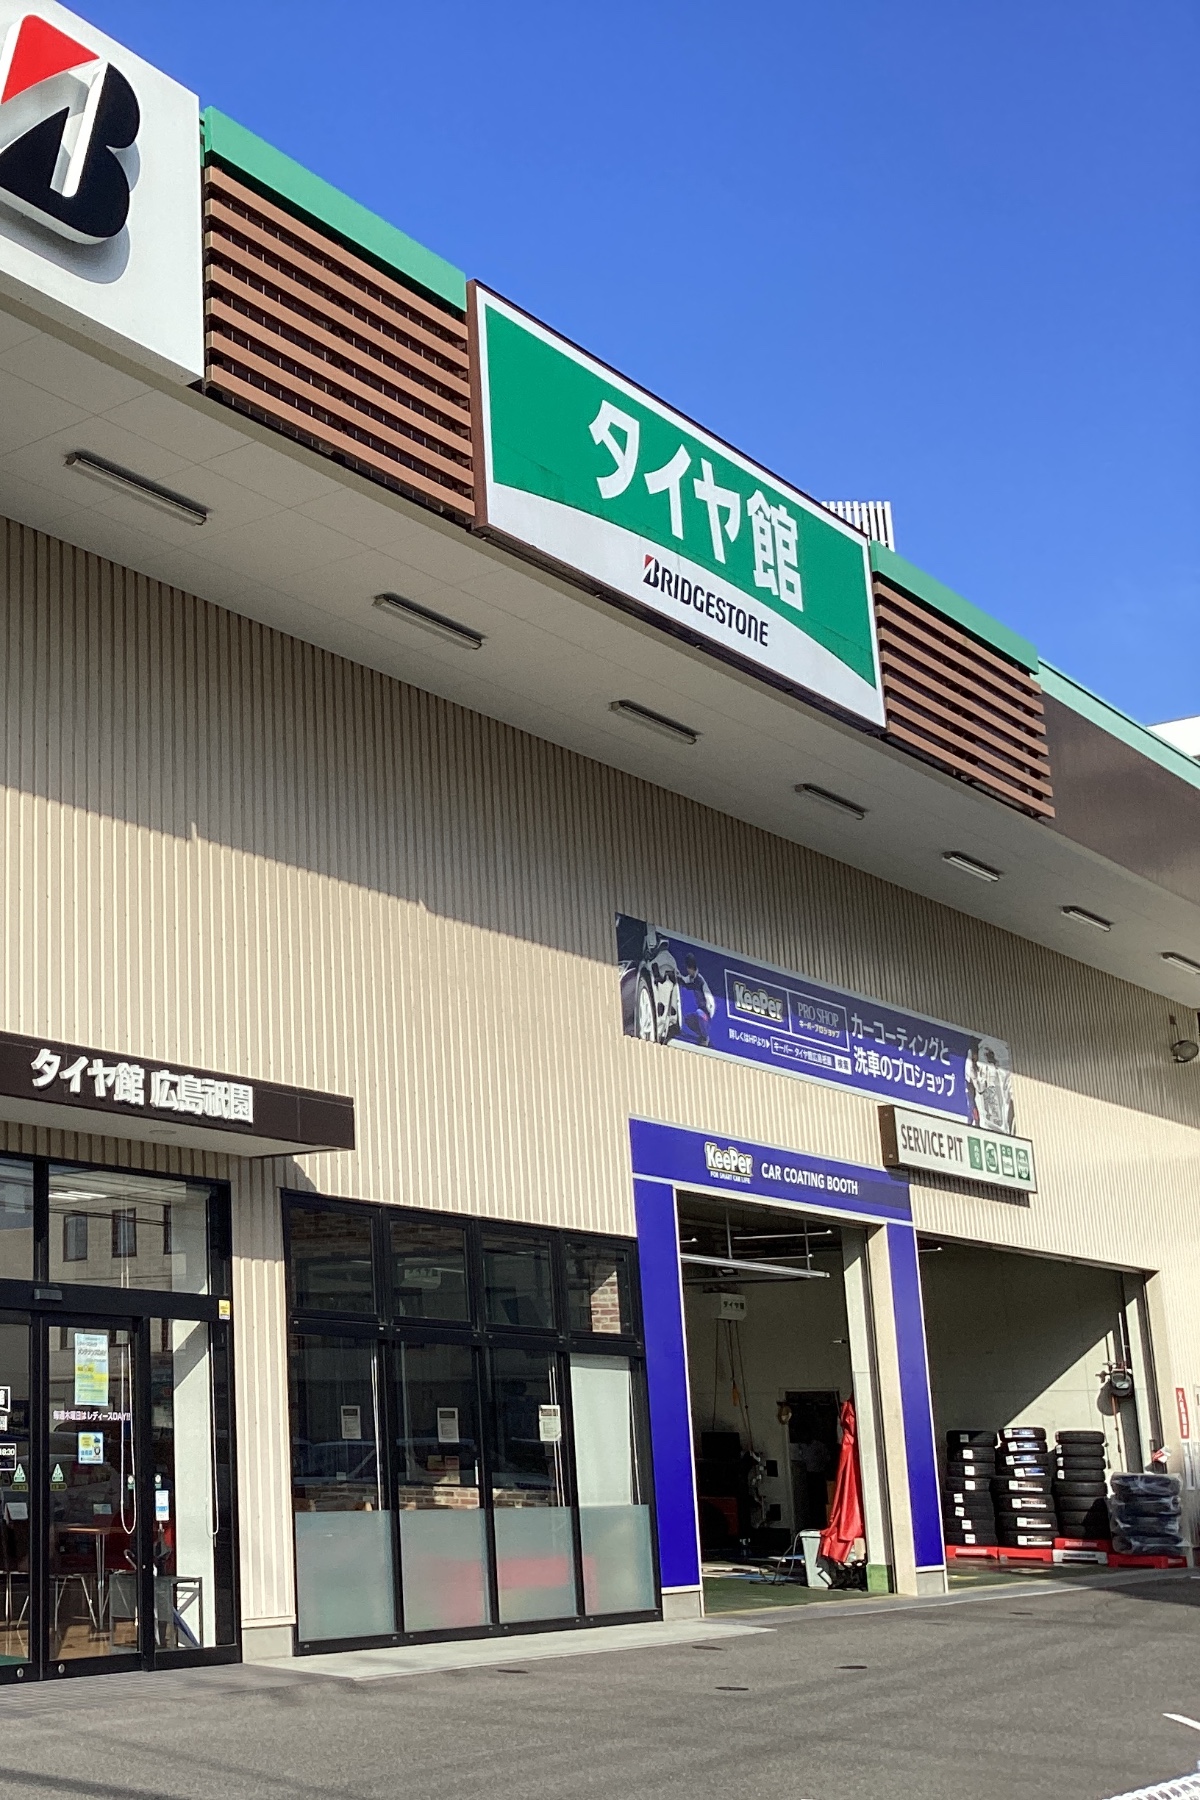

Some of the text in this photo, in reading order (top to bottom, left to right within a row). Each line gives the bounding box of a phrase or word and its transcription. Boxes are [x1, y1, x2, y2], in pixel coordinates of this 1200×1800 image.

[588, 399, 804, 612] タイヤ館
[643, 554, 769, 647] BRIDGESTONE
[734, 981, 783, 1022] KeePer
[797, 1002, 839, 1028] PRO SHOP
[799, 1020, 840, 1038] キーパープロショップ
[851, 1012, 951, 1066] カーコーティングと
[30, 1048, 254, 1123] タイヤ館 広島祇園
[853, 1045, 955, 1097] 洗車のプロショップ
[705, 1142, 753, 1176] KeePer
[900, 1123, 963, 1162] SERVICE PIT
[761, 1163, 859, 1195] CAR COATING BOOTH
